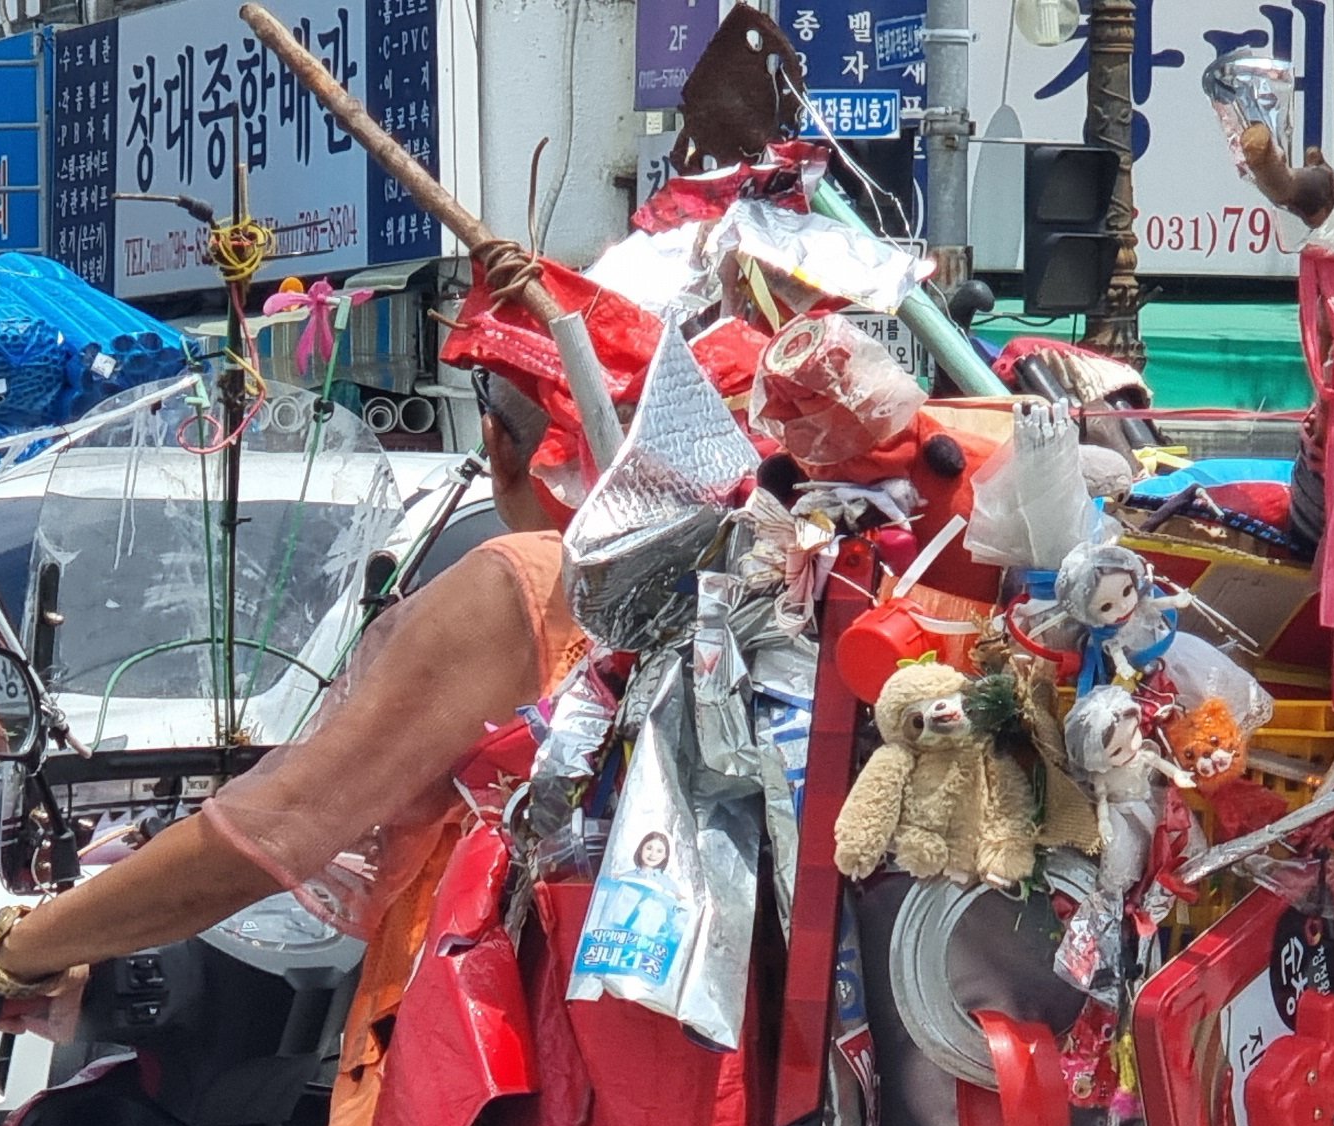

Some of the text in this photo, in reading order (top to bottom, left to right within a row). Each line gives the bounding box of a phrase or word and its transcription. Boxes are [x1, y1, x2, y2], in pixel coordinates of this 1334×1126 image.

[382, 25, 430, 61] C-PVC
[668, 25, 688, 51] 2F
[125, 5, 358, 192] 창대종합배관
[383, 99, 431, 136] 몰코부속
[384, 211, 432, 247] 위생부속
